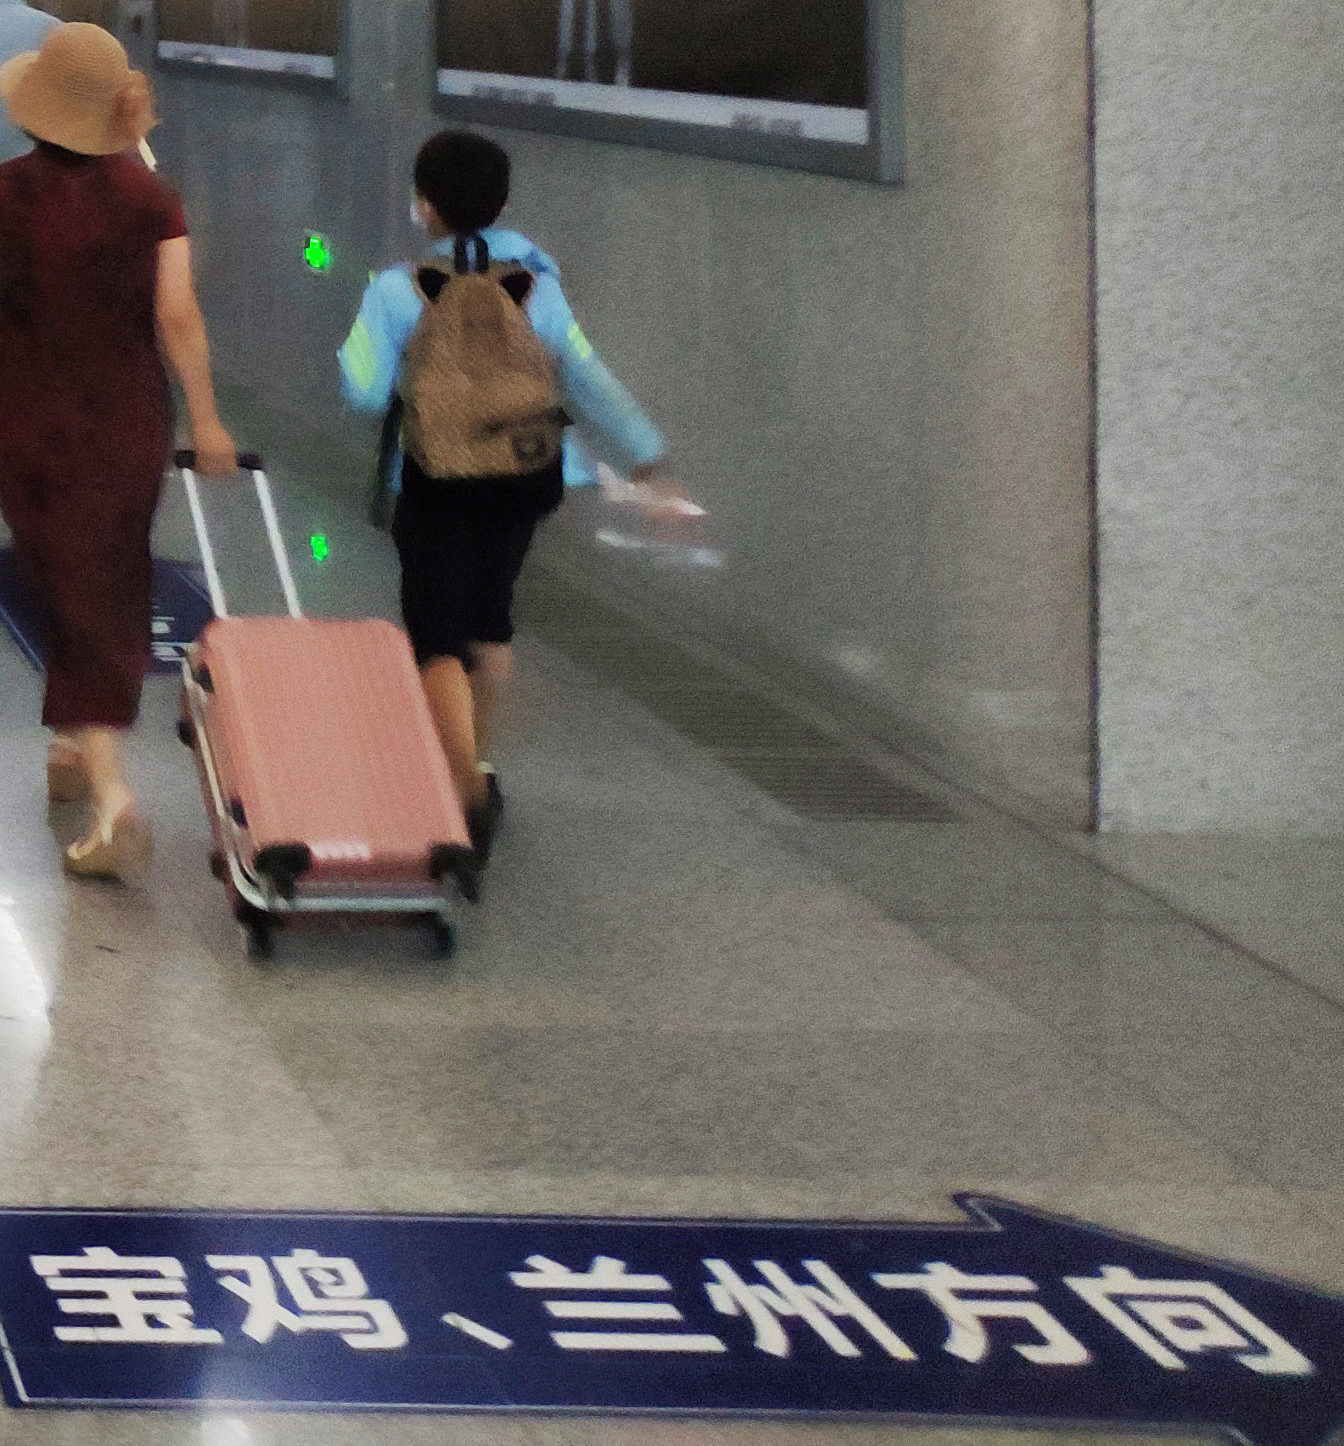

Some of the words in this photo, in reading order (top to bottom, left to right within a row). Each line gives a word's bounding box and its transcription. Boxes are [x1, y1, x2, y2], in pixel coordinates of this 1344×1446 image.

[29, 1246, 1313, 1376] 宝鸡、兰州方向
